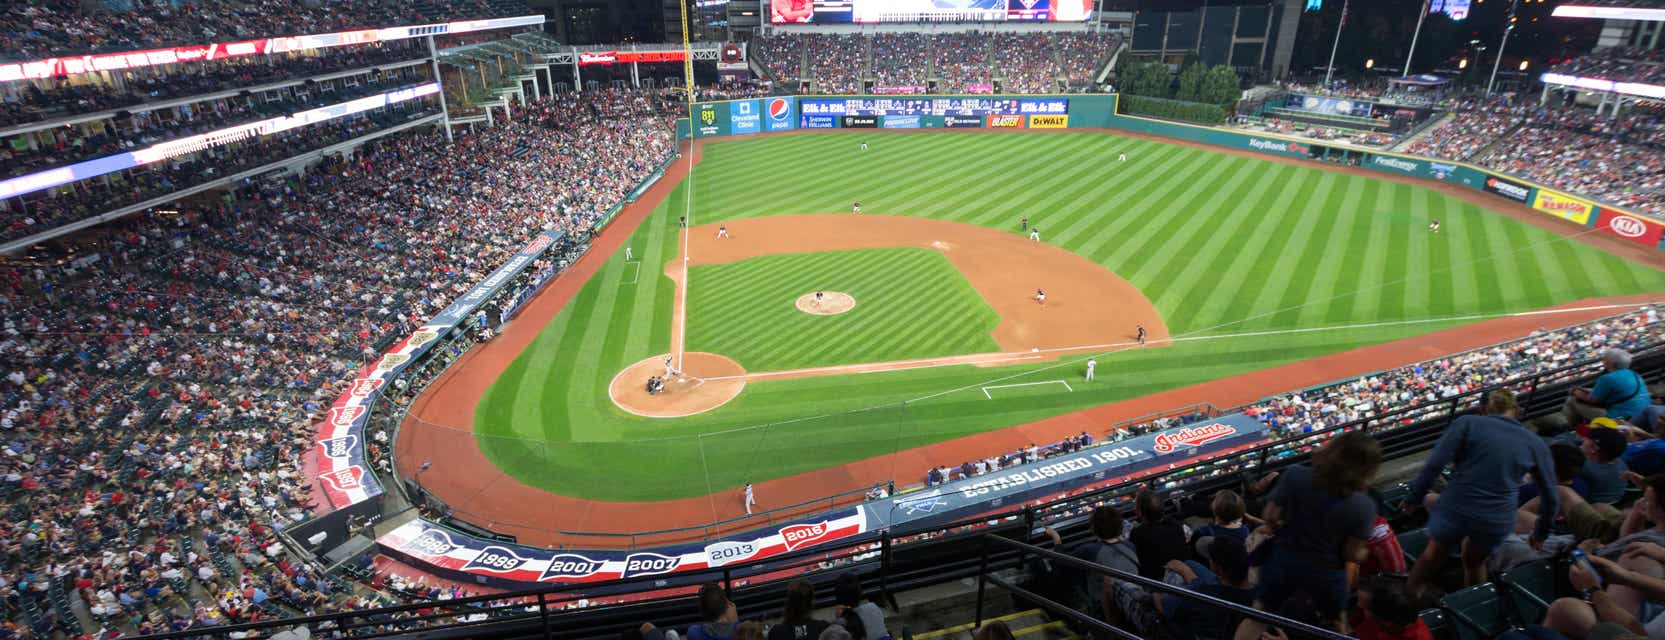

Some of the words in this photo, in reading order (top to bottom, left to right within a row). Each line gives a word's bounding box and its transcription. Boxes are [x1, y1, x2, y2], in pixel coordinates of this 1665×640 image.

[803, 103, 819, 113] Elk
[820, 103, 829, 113] &
[830, 103, 846, 113] Elk
[1021, 103, 1037, 113] Elk
[1038, 103, 1047, 112] &
[1048, 102, 1066, 112] Elk
[701, 110, 714, 121] 811
[1248, 138, 1287, 152] KeyBank
[1616, 218, 1640, 235] KIA
[1154, 423, 1236, 453] Indians
[961, 457, 1092, 498] ESTABLISHED
[785, 525, 824, 541] 2016
[711, 544, 753, 560] 2013
[475, 551, 519, 569] 1999
[550, 561, 594, 573] 2001
[630, 558, 677, 571] 2007
